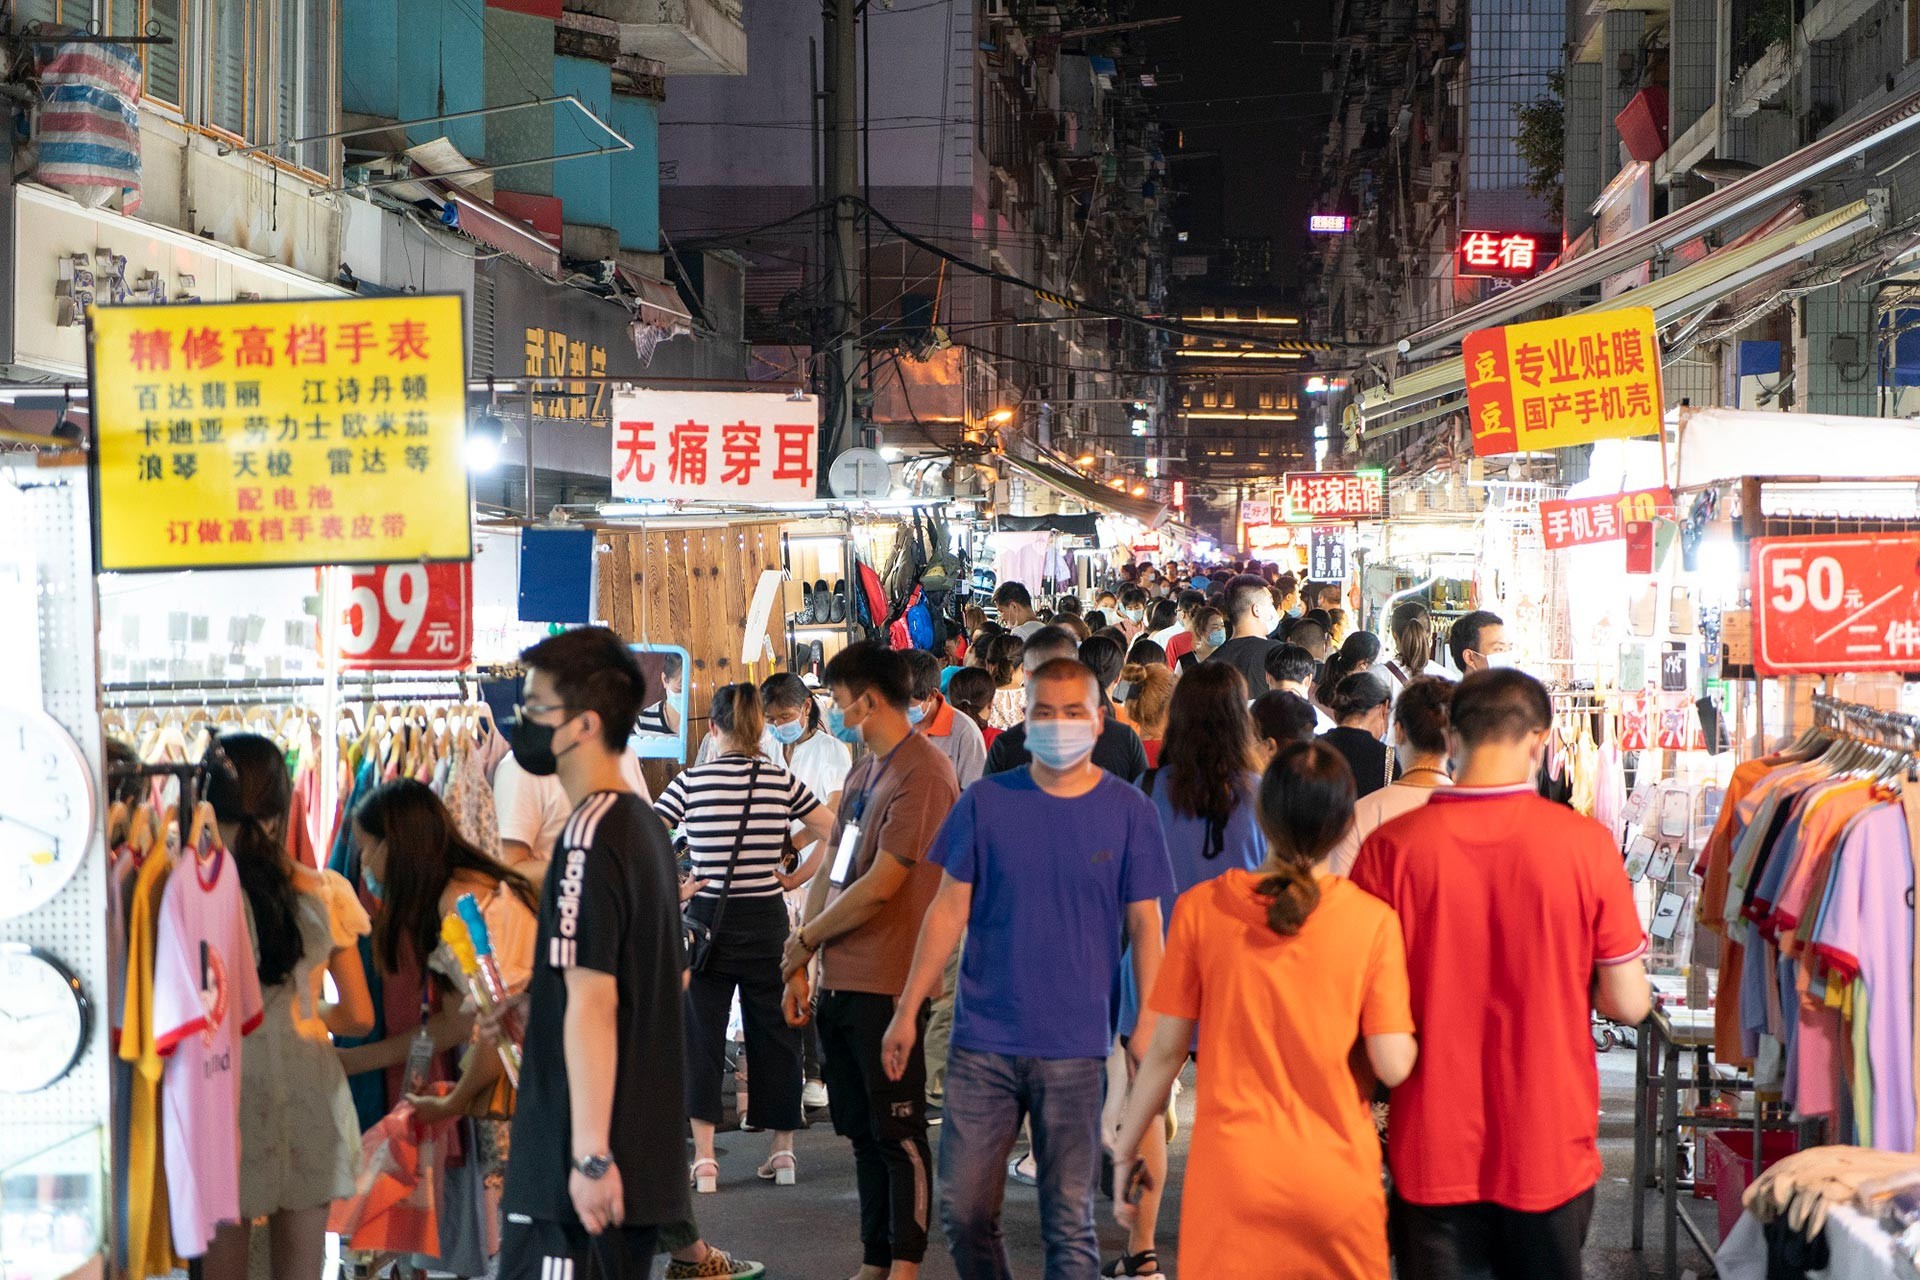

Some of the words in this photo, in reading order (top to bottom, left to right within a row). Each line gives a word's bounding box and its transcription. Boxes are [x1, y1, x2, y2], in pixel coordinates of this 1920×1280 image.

[1463, 233, 1535, 268] 住宿
[130, 319, 430, 371] 精修高档手表
[1515, 328, 1645, 388] 专业贴膜
[134, 381, 261, 411] 百达翡丽
[303, 374, 428, 404] 江诗丹顿
[1470, 351, 1512, 439] 豆豆
[1522, 383, 1652, 432] 国产手机壳
[137, 416, 224, 446] 卡迪亚
[244, 413, 331, 443] 劳力士
[342, 410, 428, 439] 欧米茄
[138, 453, 198, 481] 浪琴
[234, 451, 292, 477] 天梭
[327, 447, 387, 475] 雷达
[405, 445, 429, 473] 等
[616, 419, 815, 488] 无痛穿耳
[237, 484, 334, 511] 配电池
[1290, 478, 1380, 514] 生活家居馆
[167, 513, 407, 545] 订做高档手表皮带
[1771, 556, 1864, 613] 50元
[339, 565, 454, 655] 59元
[1846, 620, 1920, 656] 二件
[557, 850, 586, 938] adidas
